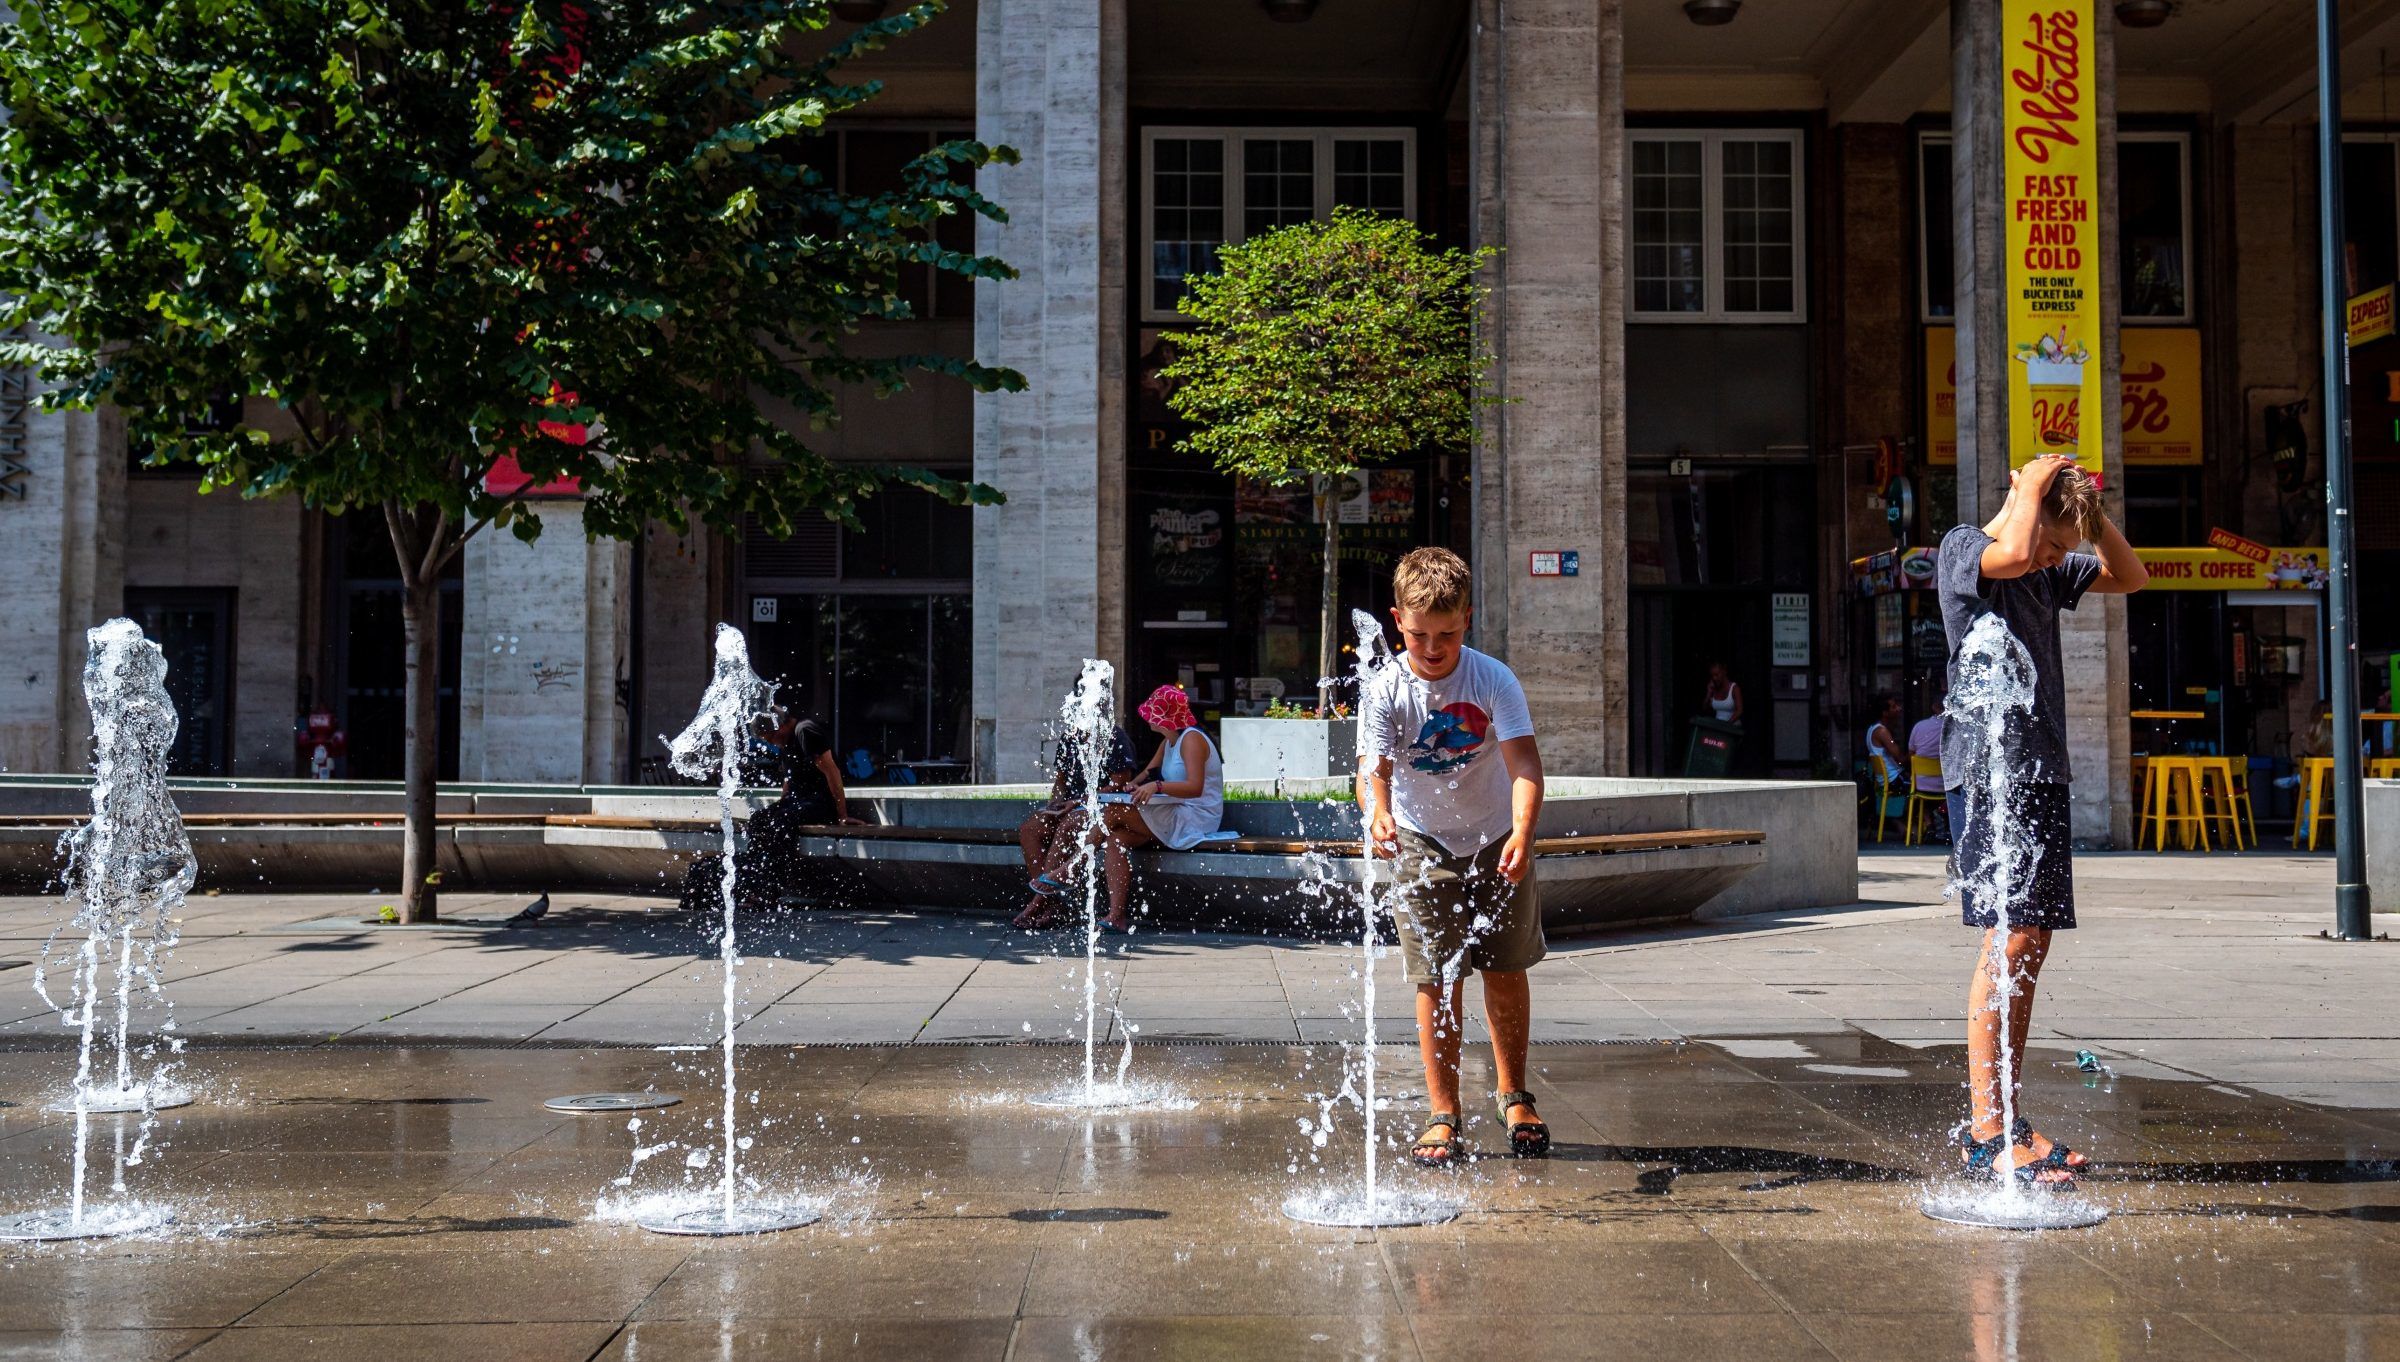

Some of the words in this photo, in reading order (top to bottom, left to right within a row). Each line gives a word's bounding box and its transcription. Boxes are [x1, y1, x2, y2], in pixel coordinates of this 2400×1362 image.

[2024, 175, 2078, 197] FAST
[2016, 199, 2087, 222] FRESH
[2029, 223, 2077, 246] AND
[2024, 247, 2082, 270] COLD
[2029, 277, 2048, 287] THE
[2050, 277, 2075, 287] ONLY
[2023, 289, 2061, 300] BUCKET
[2063, 289, 2084, 300] BAR
[2032, 301, 2076, 312] EXPRESS
[2351, 293, 2391, 326] EXPRESS
[1677, 461, 1684, 474] 5
[1150, 513, 1204, 534] Pointer
[1239, 527, 1306, 538] SIMPLY
[1319, 527, 1354, 538] TE
[1362, 527, 1409, 538] BEER
[1190, 534, 1217, 546] PUB
[2212, 533, 2237, 549] AND
[2239, 541, 2268, 562] BEER
[2144, 561, 2192, 579] SHOTS
[2200, 561, 2257, 579] COFFEE
